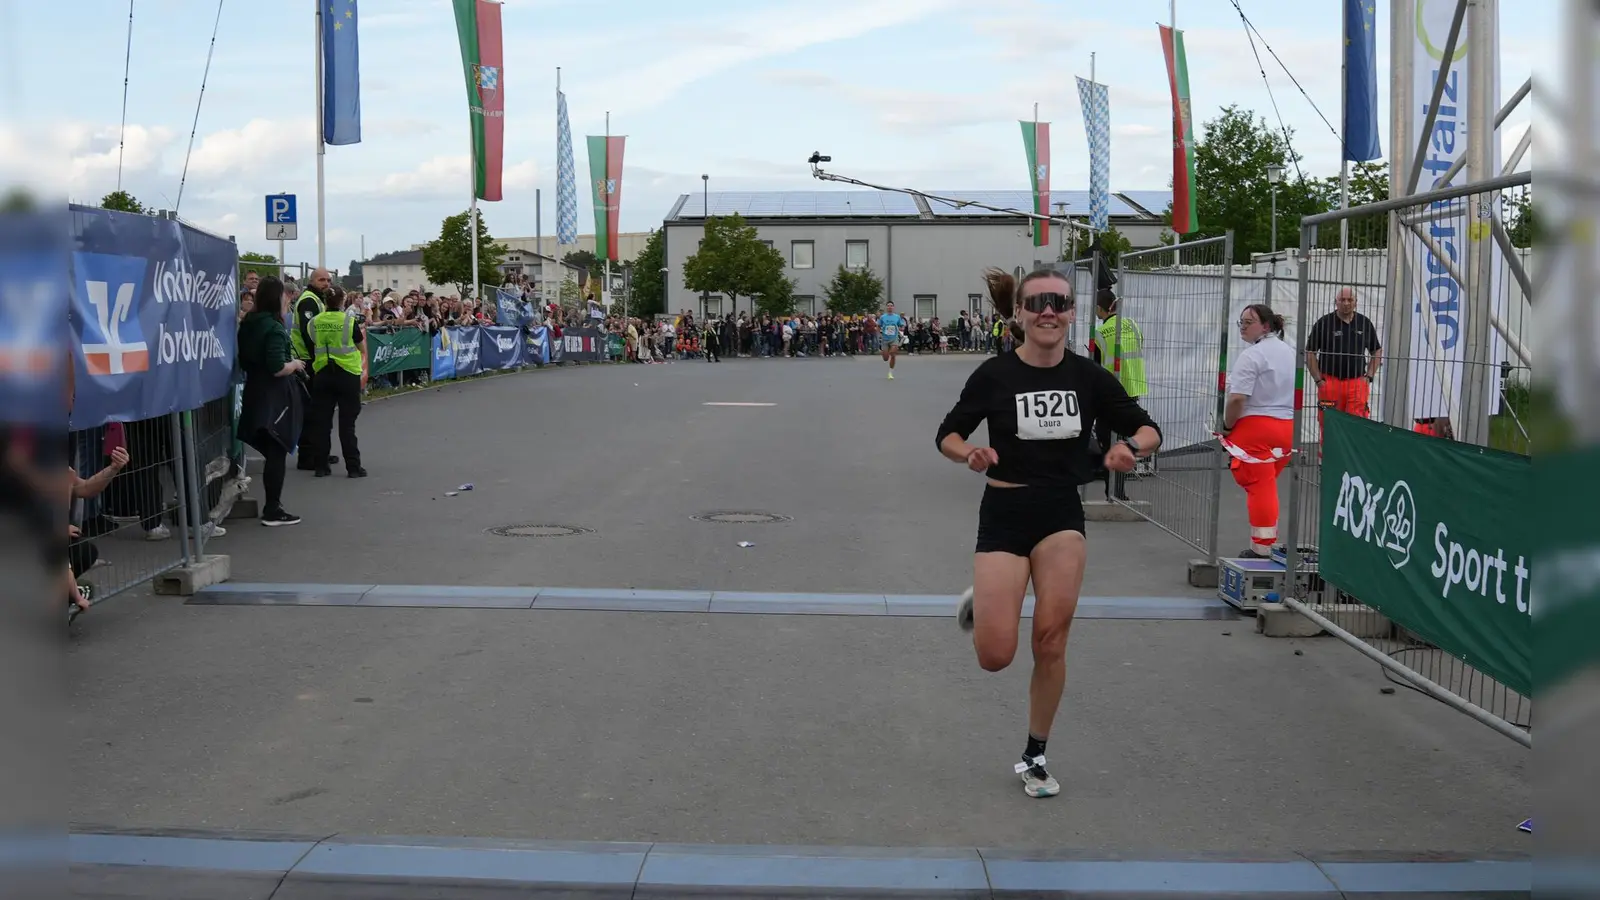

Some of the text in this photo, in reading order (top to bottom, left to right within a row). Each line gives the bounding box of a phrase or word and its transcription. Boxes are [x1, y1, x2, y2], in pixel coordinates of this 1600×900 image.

[272, 198, 289, 222] P
[1018, 392, 1079, 418] 1520
[1431, 522, 1507, 604] Sport
[1515, 556, 1531, 616] t
